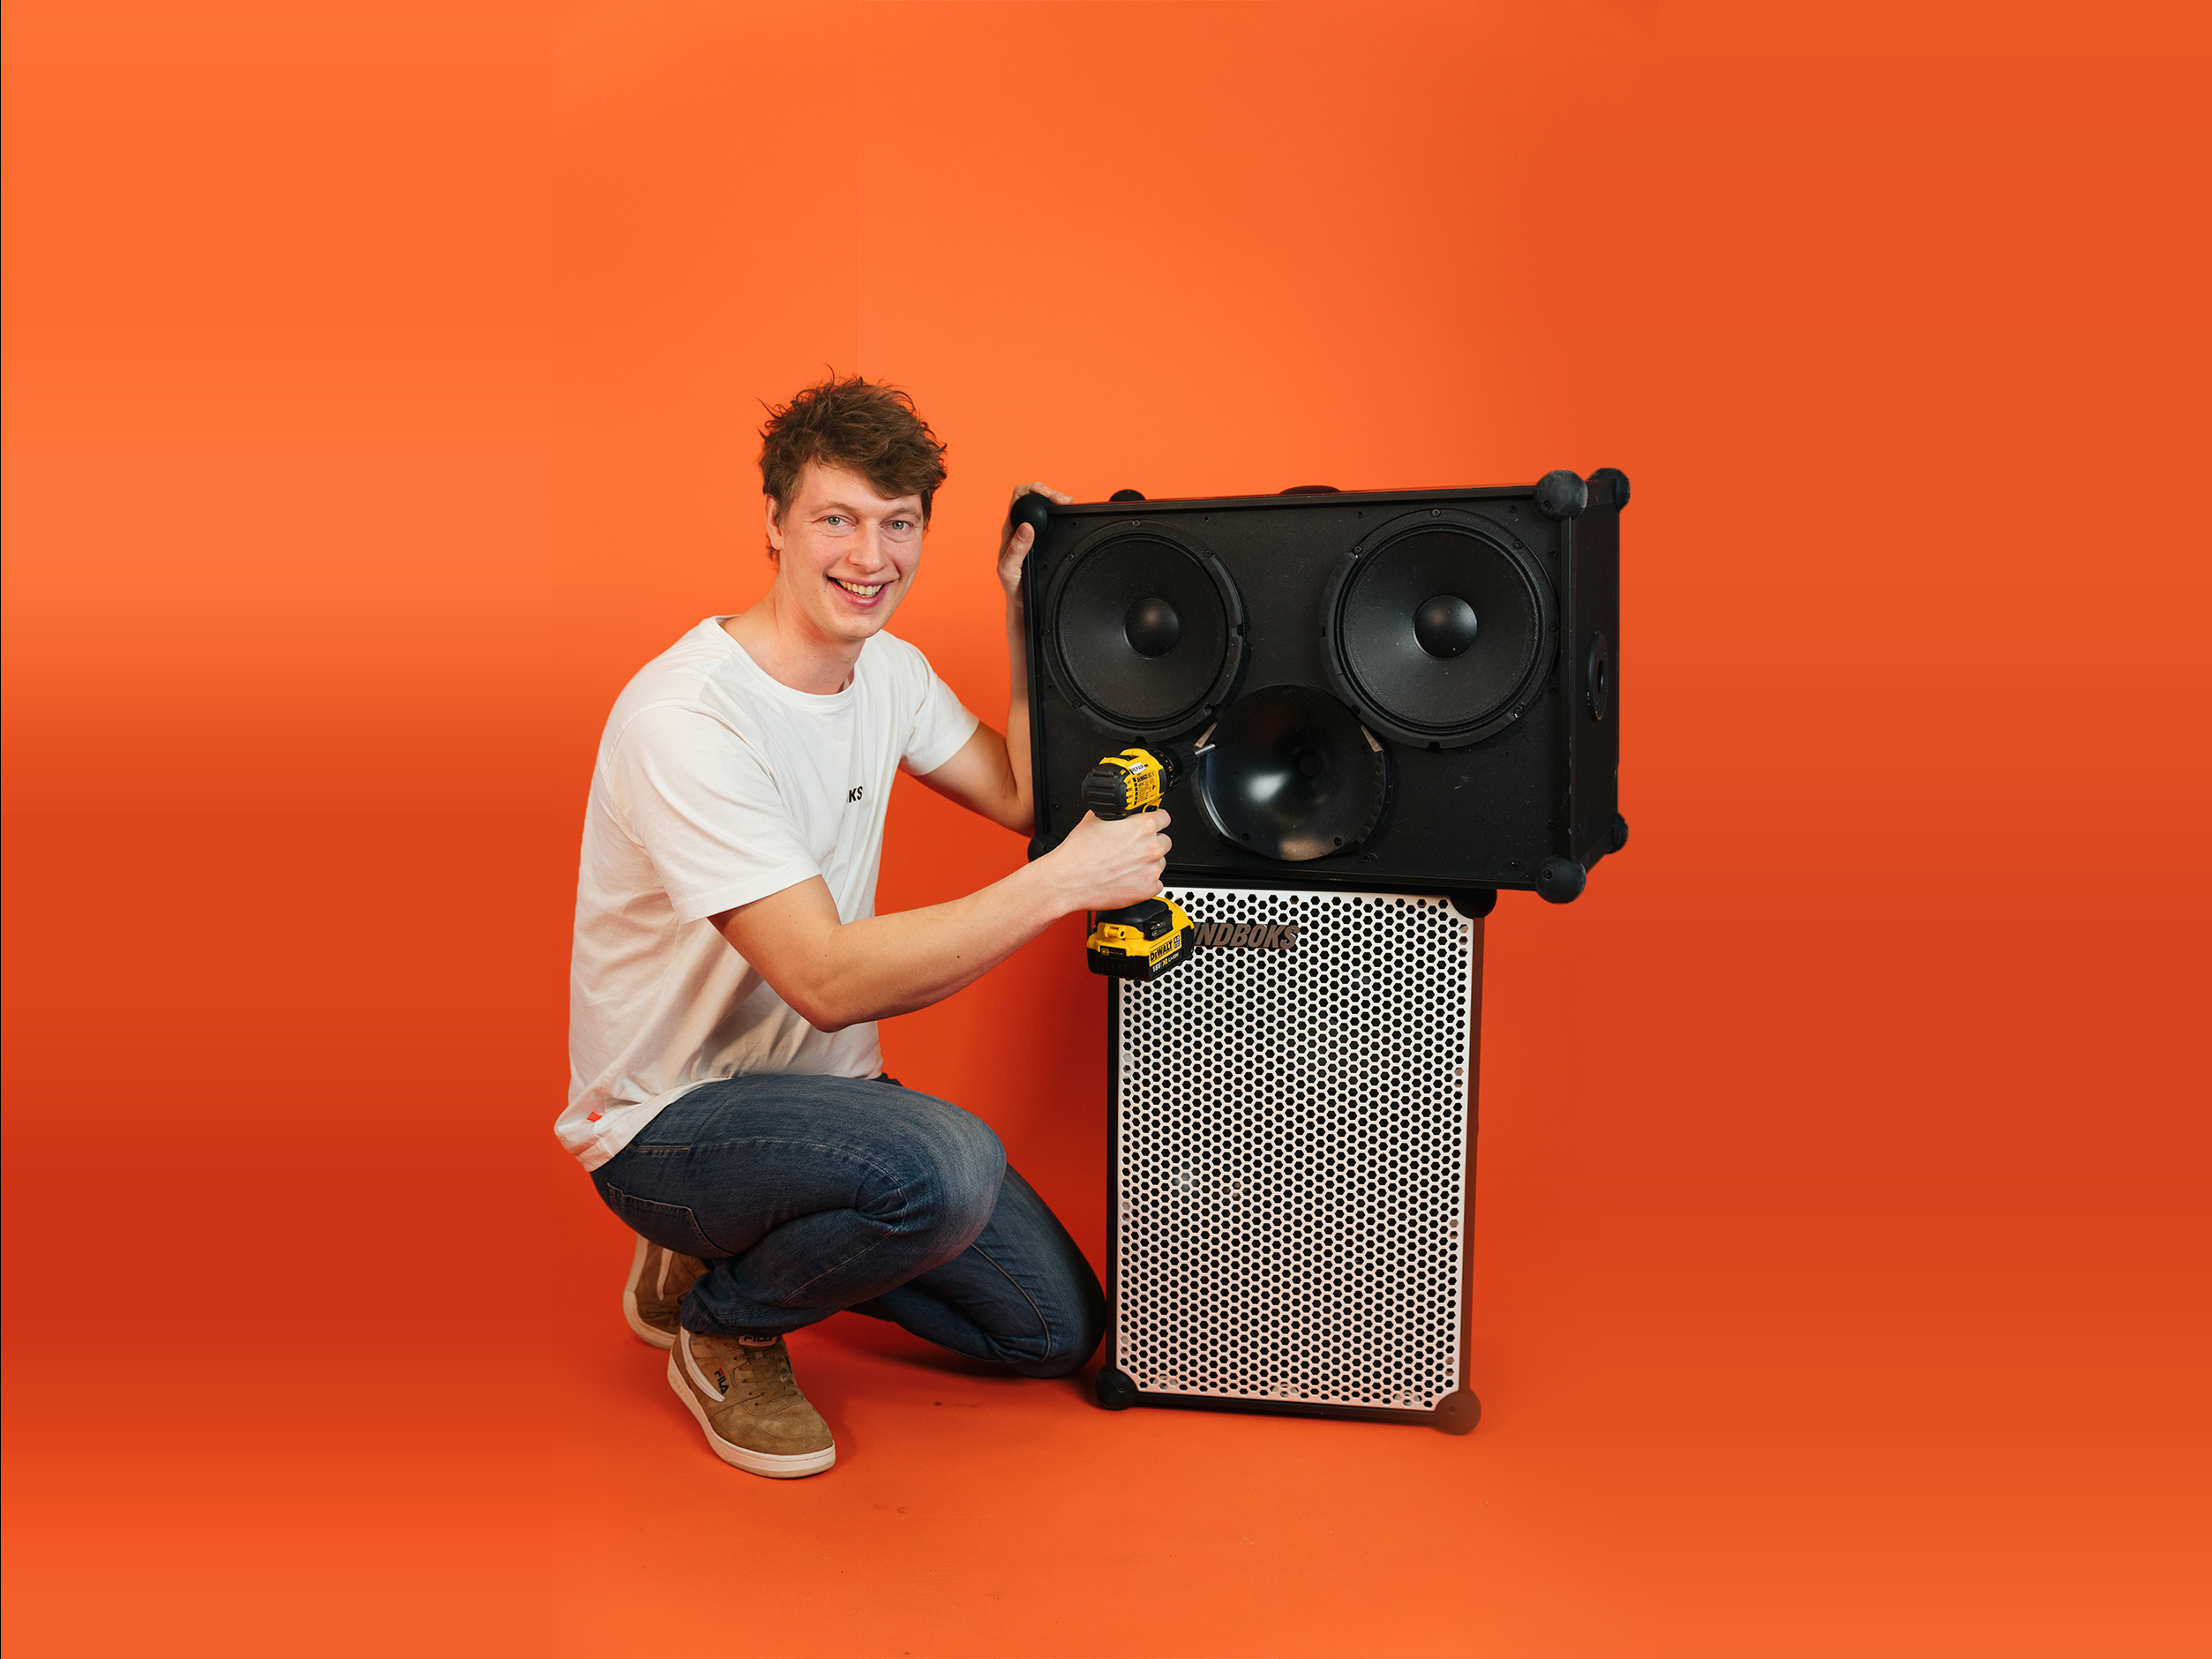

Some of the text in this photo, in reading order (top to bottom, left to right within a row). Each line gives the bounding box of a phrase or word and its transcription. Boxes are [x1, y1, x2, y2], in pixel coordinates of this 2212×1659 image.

[1130, 764, 1145, 773] REPAIR
[848, 785, 864, 804] KS
[1150, 940, 1173, 962] DEWALT
[714, 1367, 730, 1395] FILA
